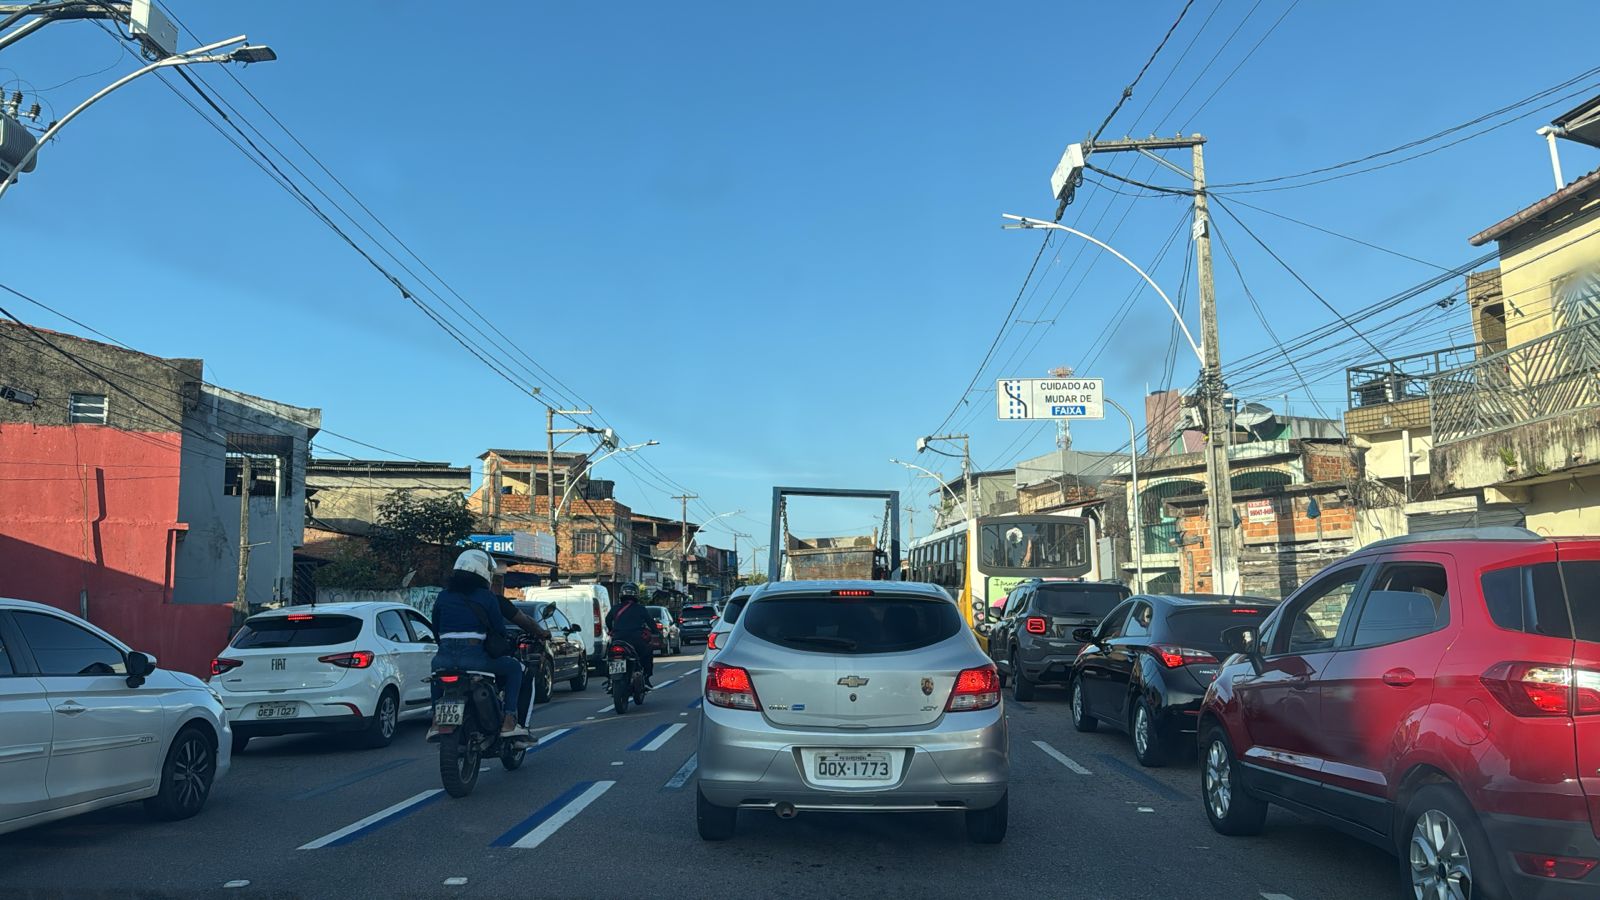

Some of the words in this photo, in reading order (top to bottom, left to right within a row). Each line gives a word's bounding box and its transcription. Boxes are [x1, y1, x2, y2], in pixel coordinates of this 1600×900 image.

[1040, 382, 1081, 390] CUIDADO
[1083, 382, 1096, 390] AO
[1045, 395, 1077, 403] MUDAR
[1080, 395, 1092, 403] DE
[1055, 406, 1082, 414] FAIXA
[271, 658, 287, 671] FIAT
[440, 704, 459, 714] RXC
